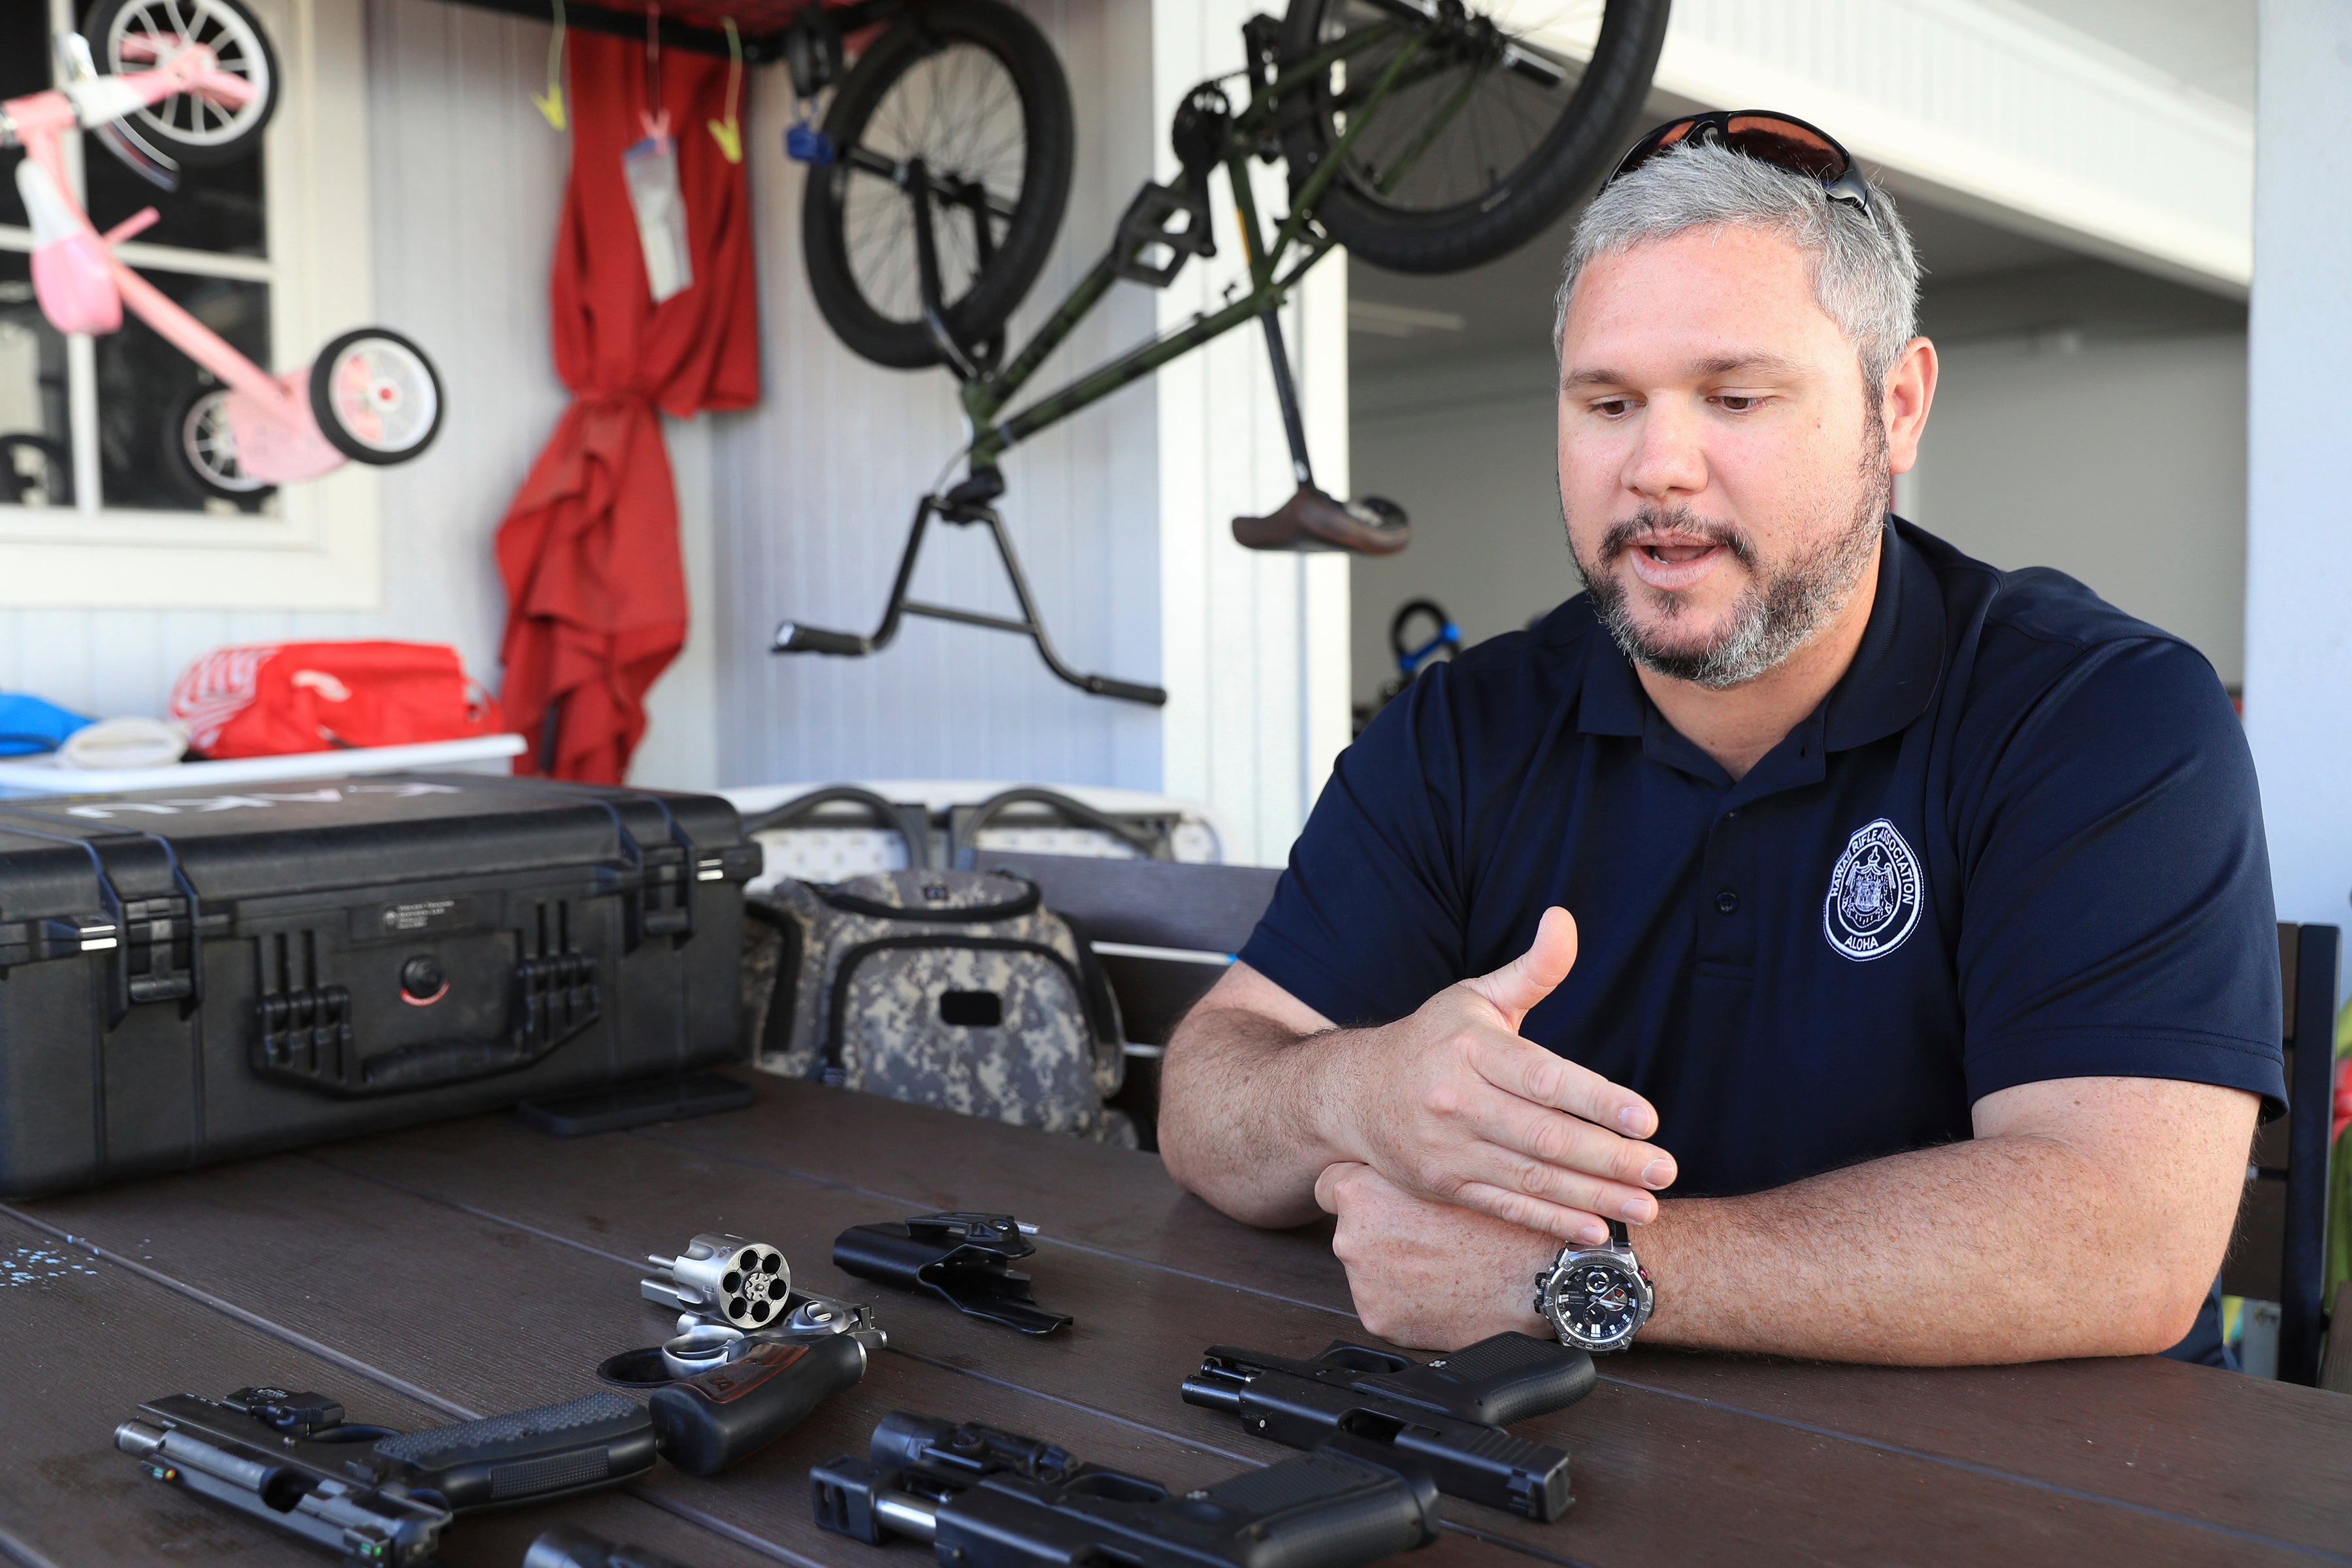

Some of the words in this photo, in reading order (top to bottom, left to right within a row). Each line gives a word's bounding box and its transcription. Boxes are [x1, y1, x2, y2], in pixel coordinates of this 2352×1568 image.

[1830, 849, 1853, 897] HAWAII
[1852, 830, 1878, 853] RIFLE
[1877, 828, 1914, 906] ASSOCIATION
[1844, 935, 1879, 951] ALOHA
[1574, 1256, 1598, 1266] RESIST
[1600, 1256, 1624, 1267] SHOCK
[1573, 1338, 1619, 1349] G-SHOCK
